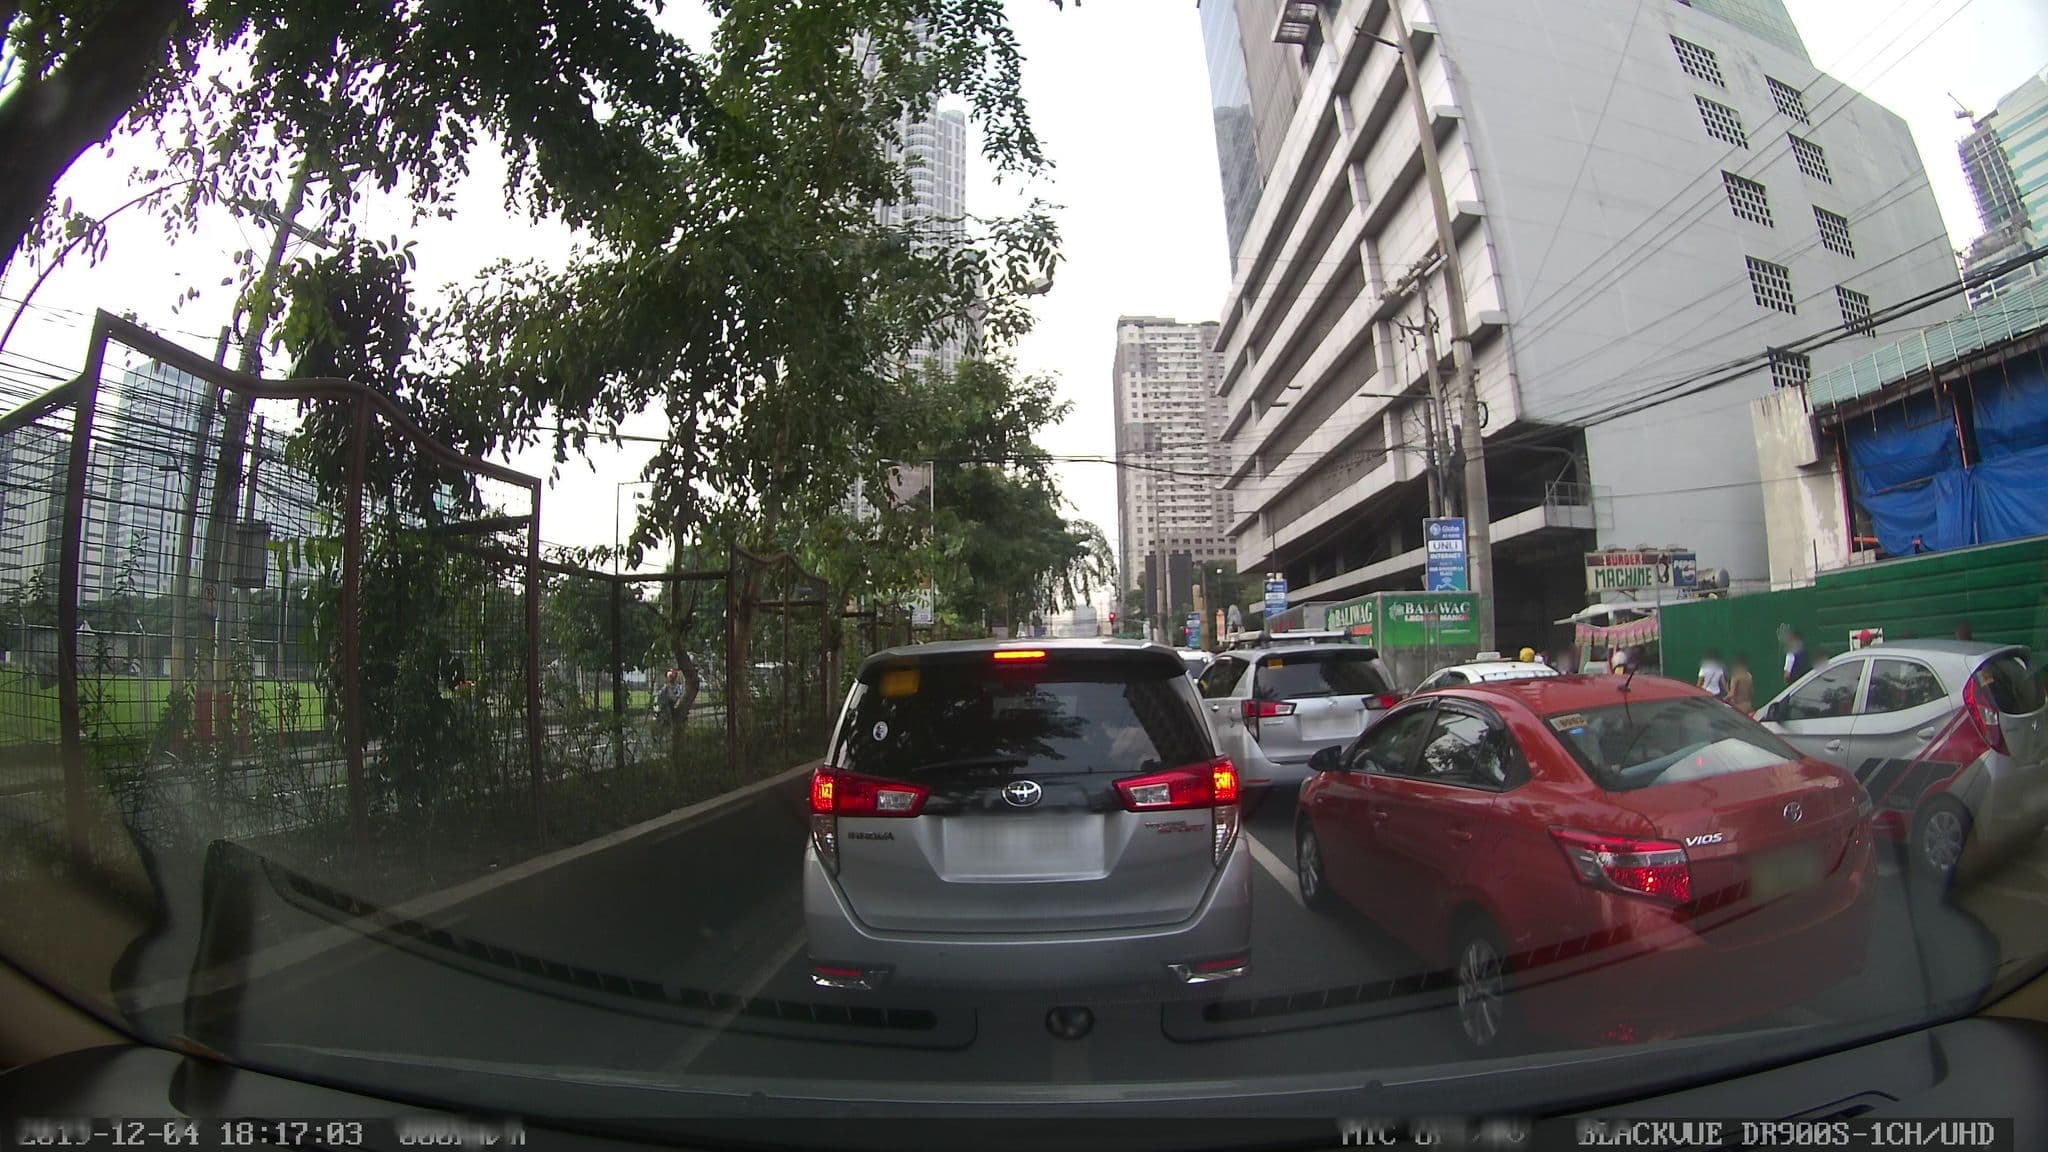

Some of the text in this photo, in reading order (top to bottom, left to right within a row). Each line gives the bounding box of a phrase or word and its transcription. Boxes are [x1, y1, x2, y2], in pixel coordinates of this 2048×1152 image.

[1433, 542, 1458, 551] UNLI
[1605, 554, 1642, 568] BURGER
[1595, 567, 1652, 589] MACHINE
[1335, 602, 1373, 627] BALIWAG
[1405, 602, 1471, 614] BALIWAG
[1686, 832, 1723, 848] VIOS
